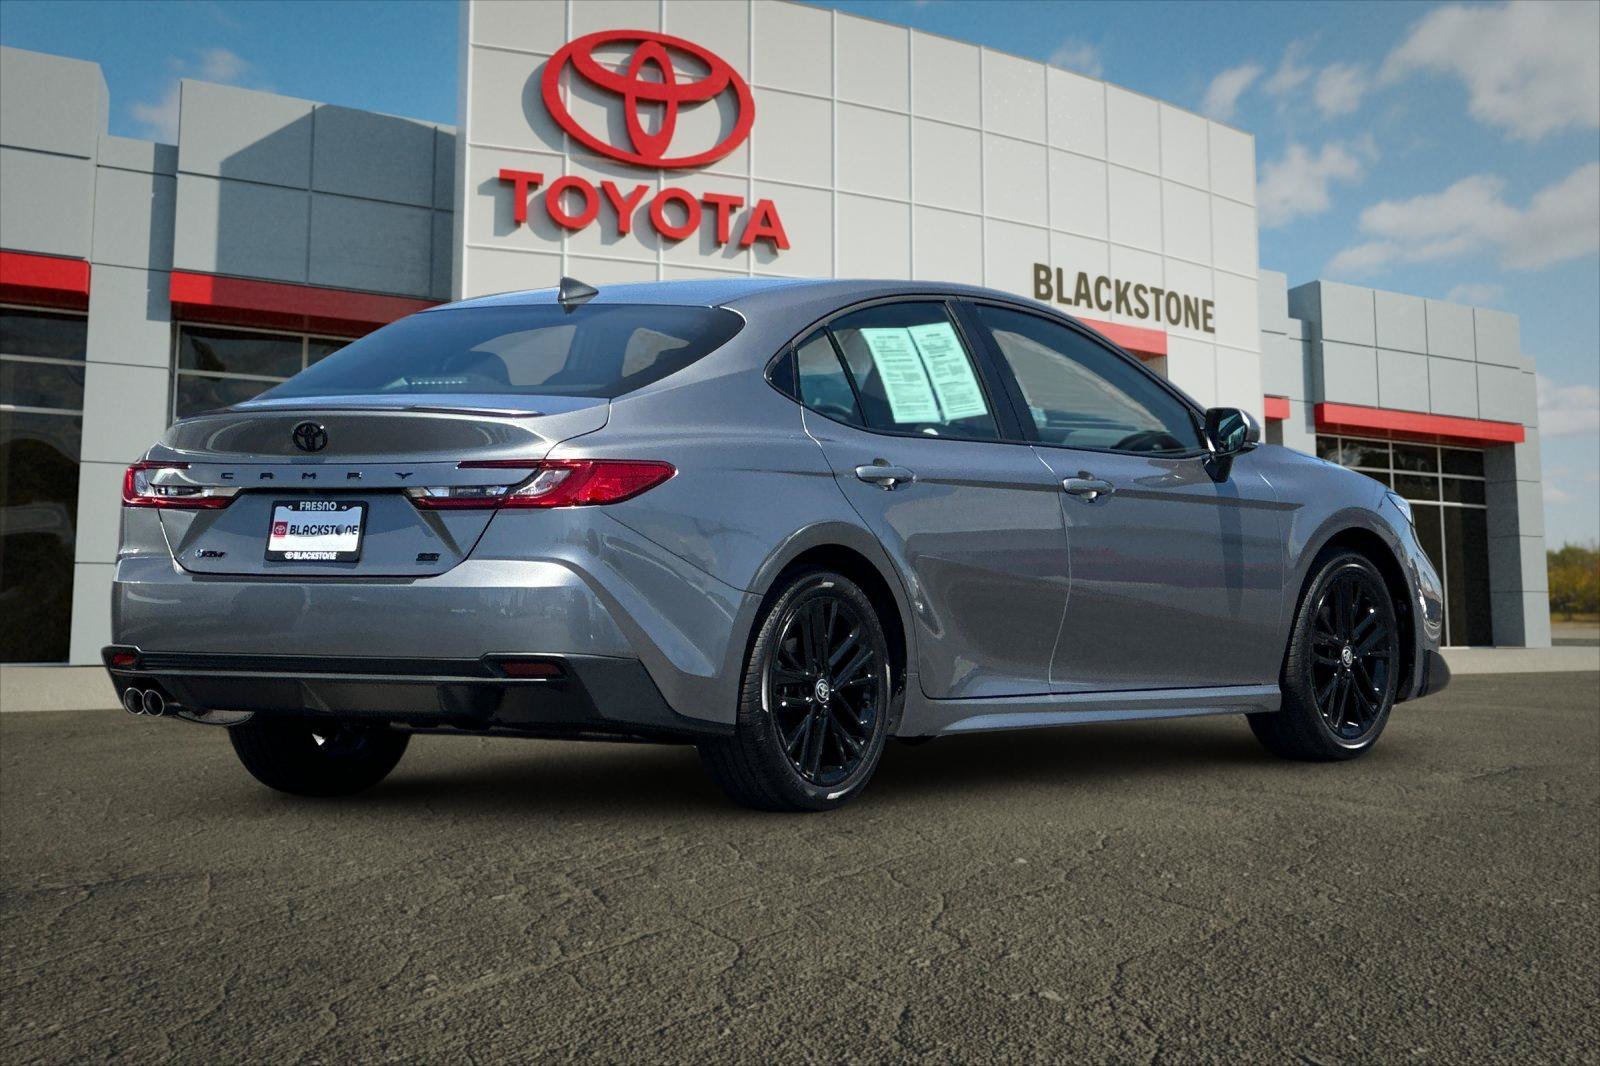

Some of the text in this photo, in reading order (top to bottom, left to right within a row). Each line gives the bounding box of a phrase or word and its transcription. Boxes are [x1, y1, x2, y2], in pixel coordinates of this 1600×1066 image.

[498, 168, 791, 251] TOYOTA
[1033, 263, 1216, 334] BLACKSTONE
[299, 501, 337, 511] FRESNO
[293, 551, 337, 560] BLACKSTONE
